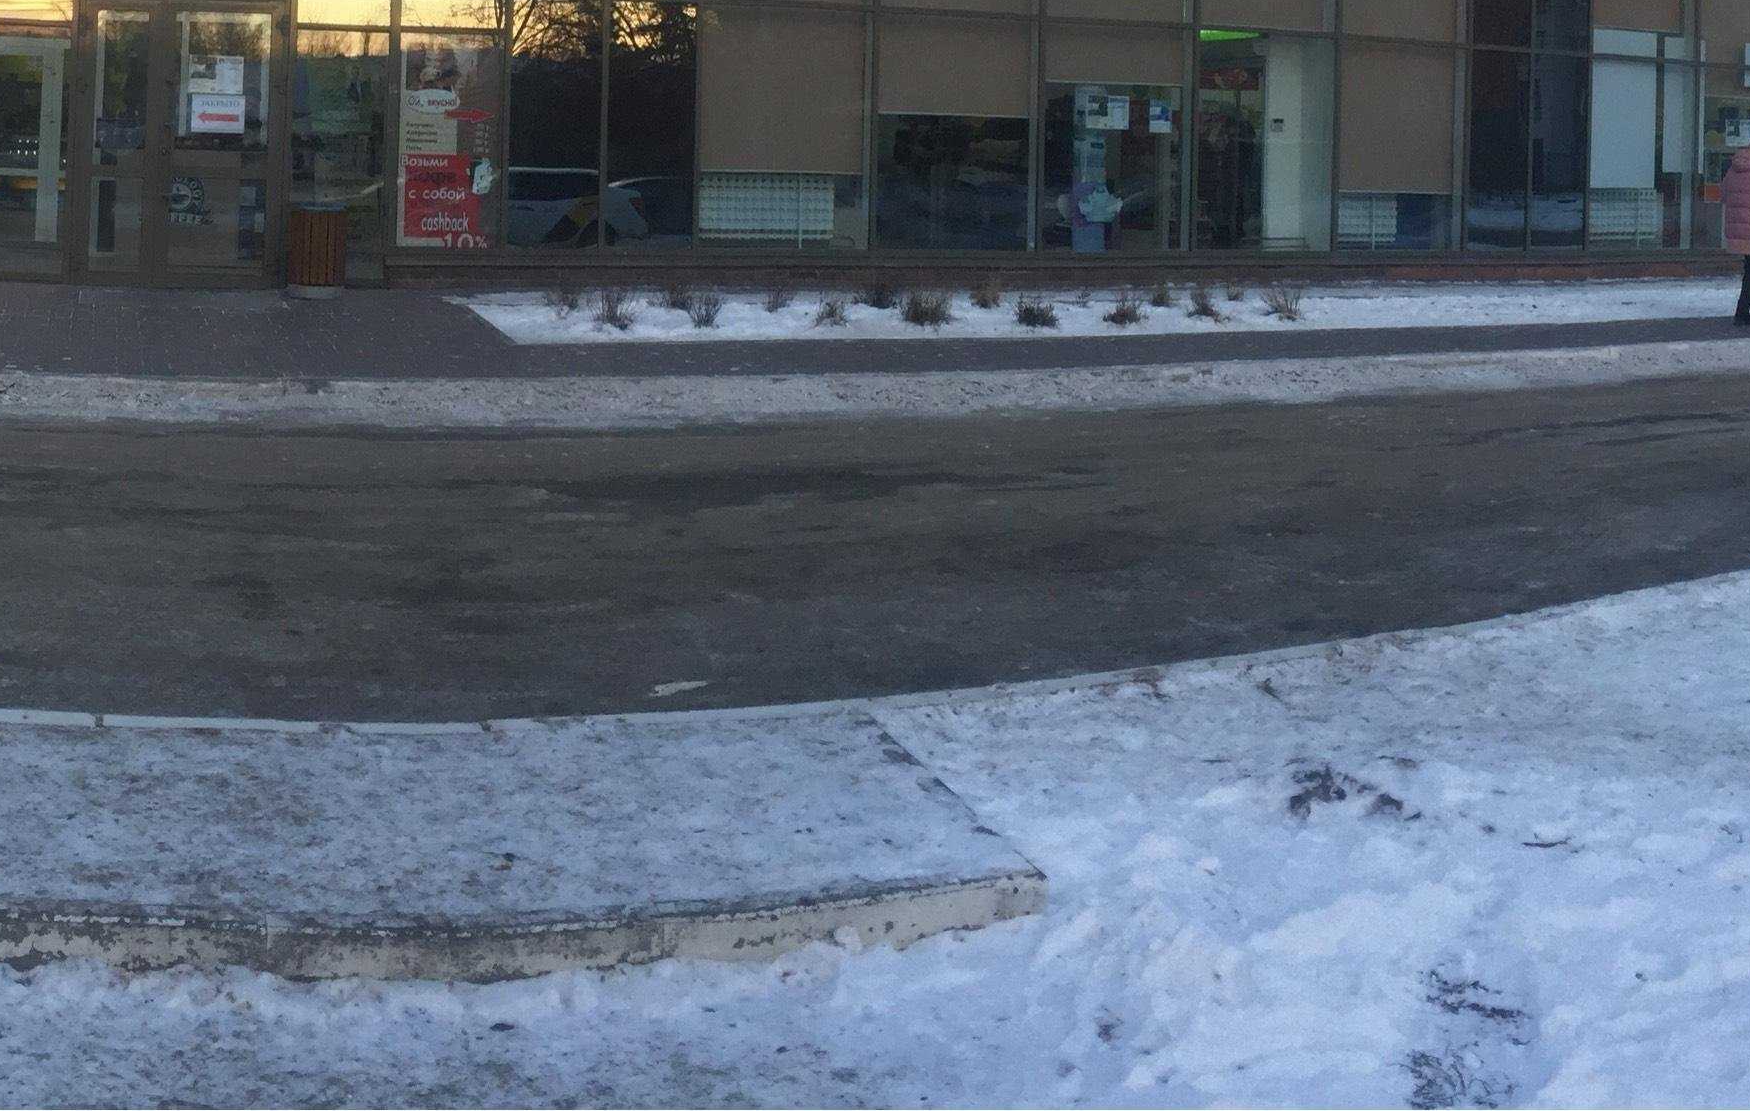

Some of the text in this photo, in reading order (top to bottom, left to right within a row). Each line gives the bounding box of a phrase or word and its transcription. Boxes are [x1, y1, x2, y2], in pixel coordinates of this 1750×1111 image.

[401, 154, 449, 167] Возьми
[422, 187, 467, 200] собой
[421, 212, 469, 231] cashback
